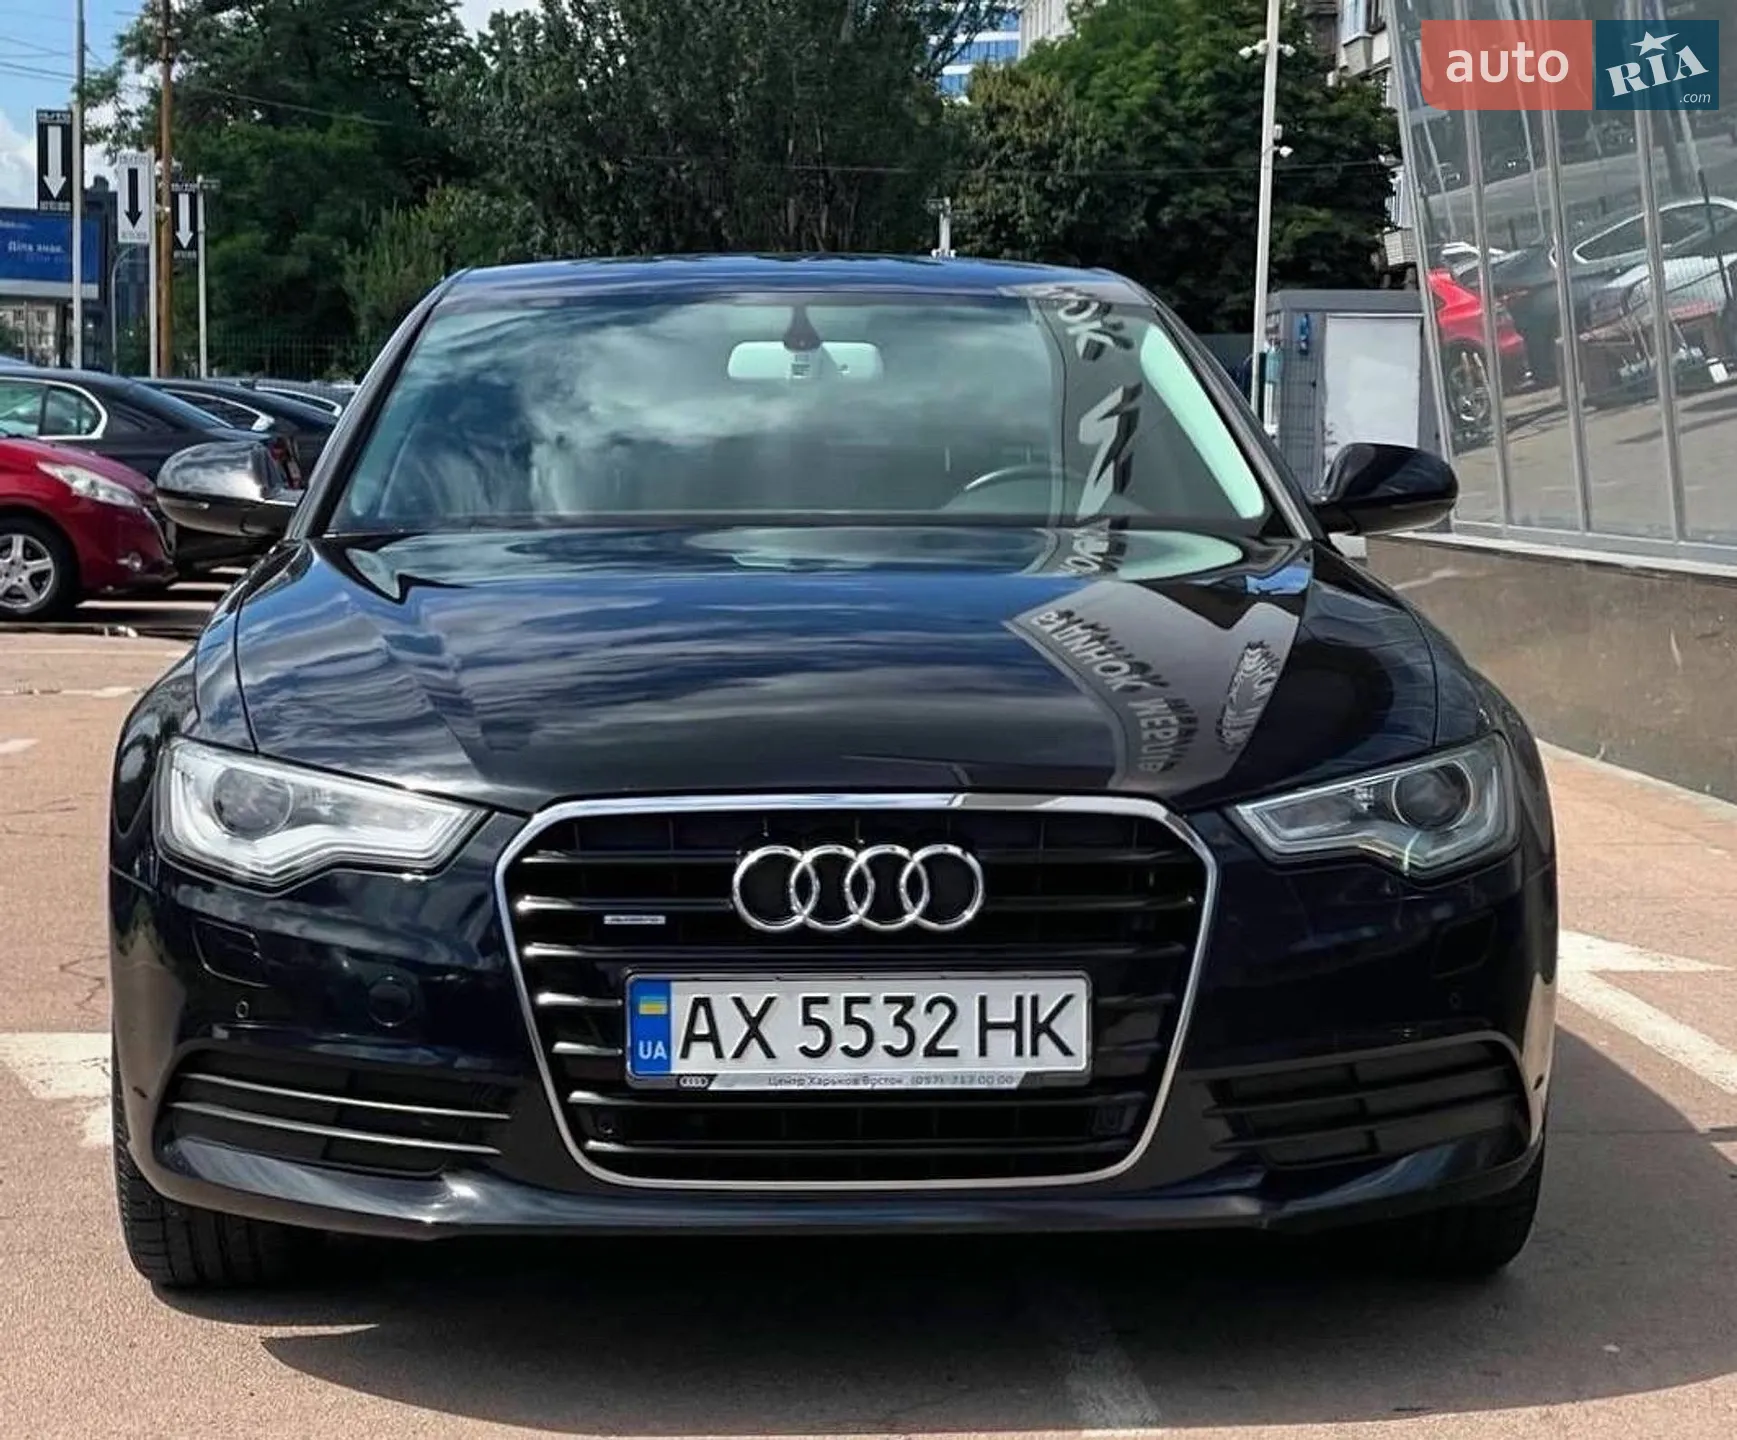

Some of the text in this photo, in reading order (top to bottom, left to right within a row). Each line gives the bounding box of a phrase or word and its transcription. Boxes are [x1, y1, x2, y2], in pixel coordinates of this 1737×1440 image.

[680, 994, 1075, 1059] AX 5532 HK
[639, 1043, 667, 1060] UA
